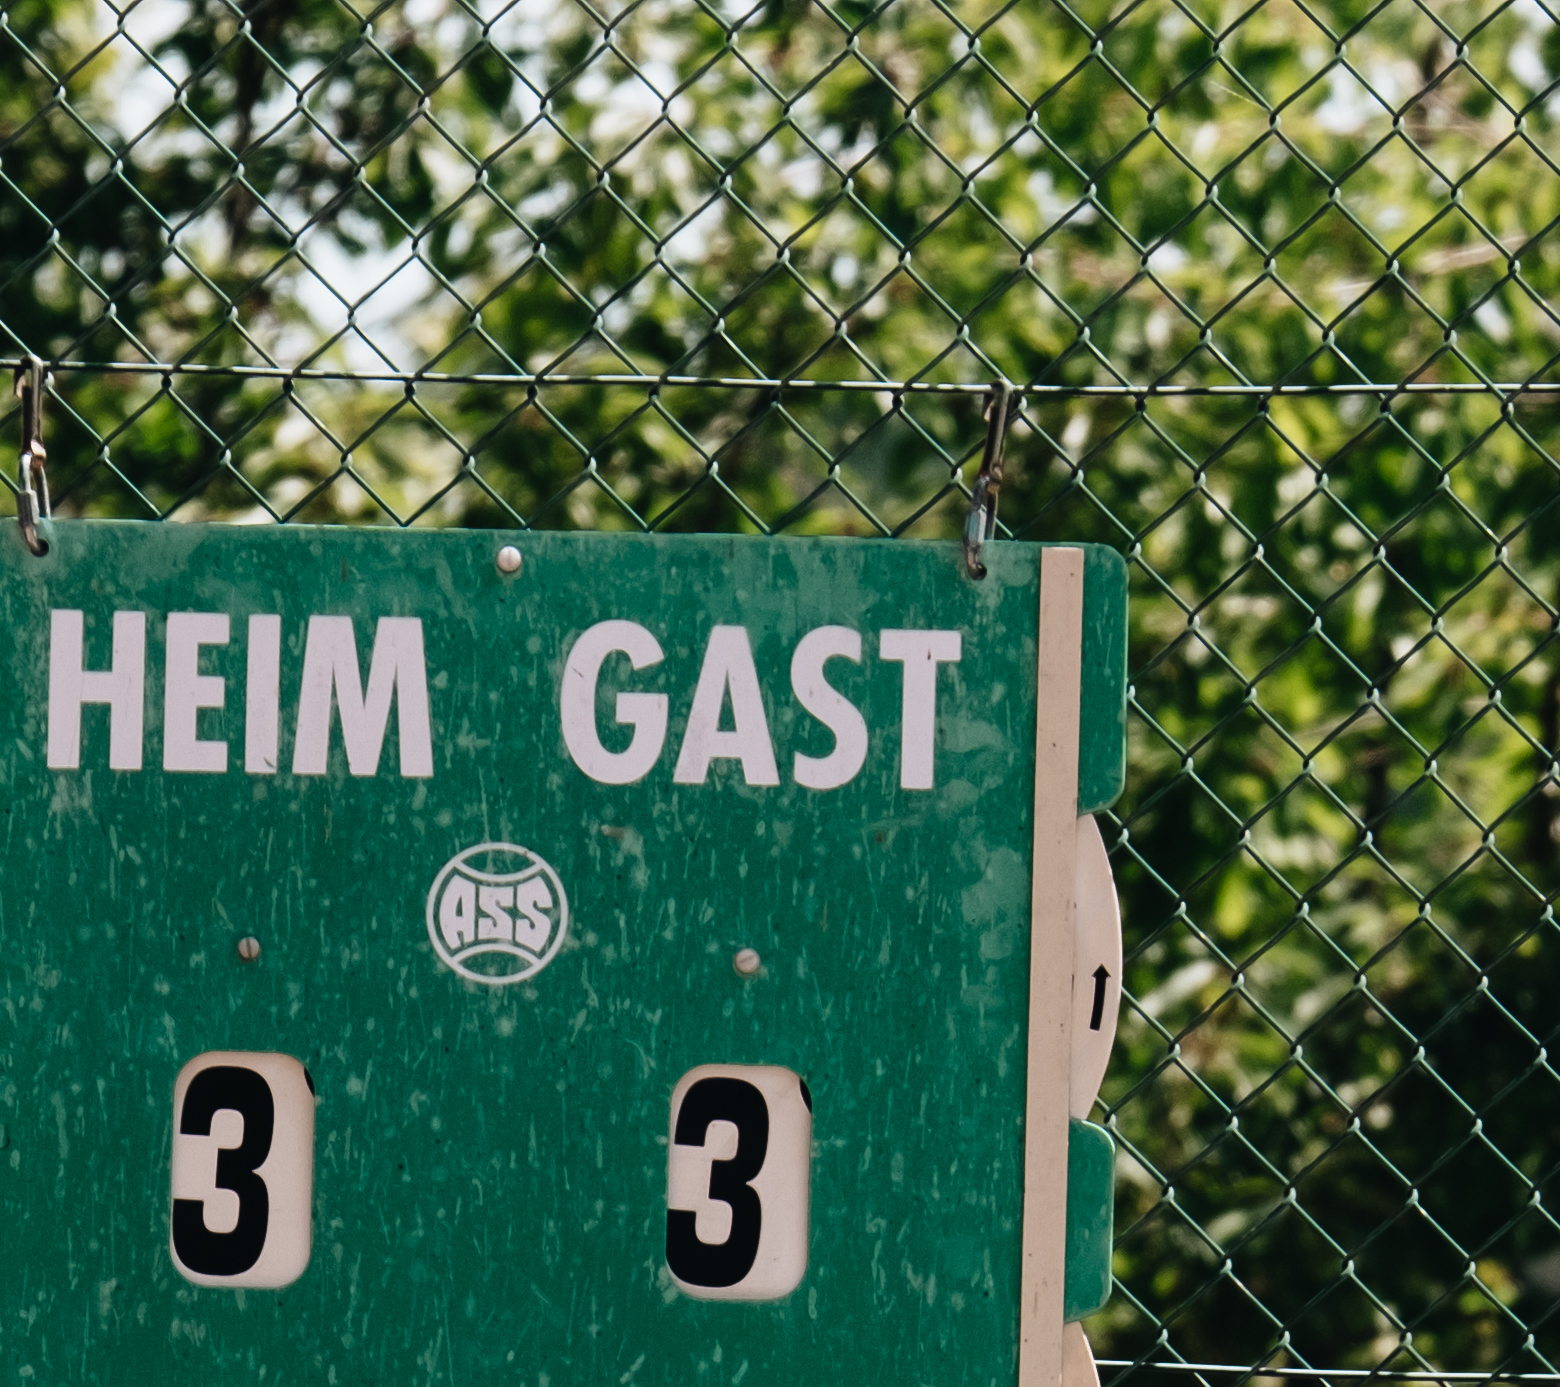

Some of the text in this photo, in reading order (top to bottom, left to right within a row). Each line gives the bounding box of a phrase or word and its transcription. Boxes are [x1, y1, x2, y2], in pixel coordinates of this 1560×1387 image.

[47, 609, 962, 790] HEIM GAST
[439, 874, 553, 953] ASS
[171, 1066, 769, 1288] 3 3
